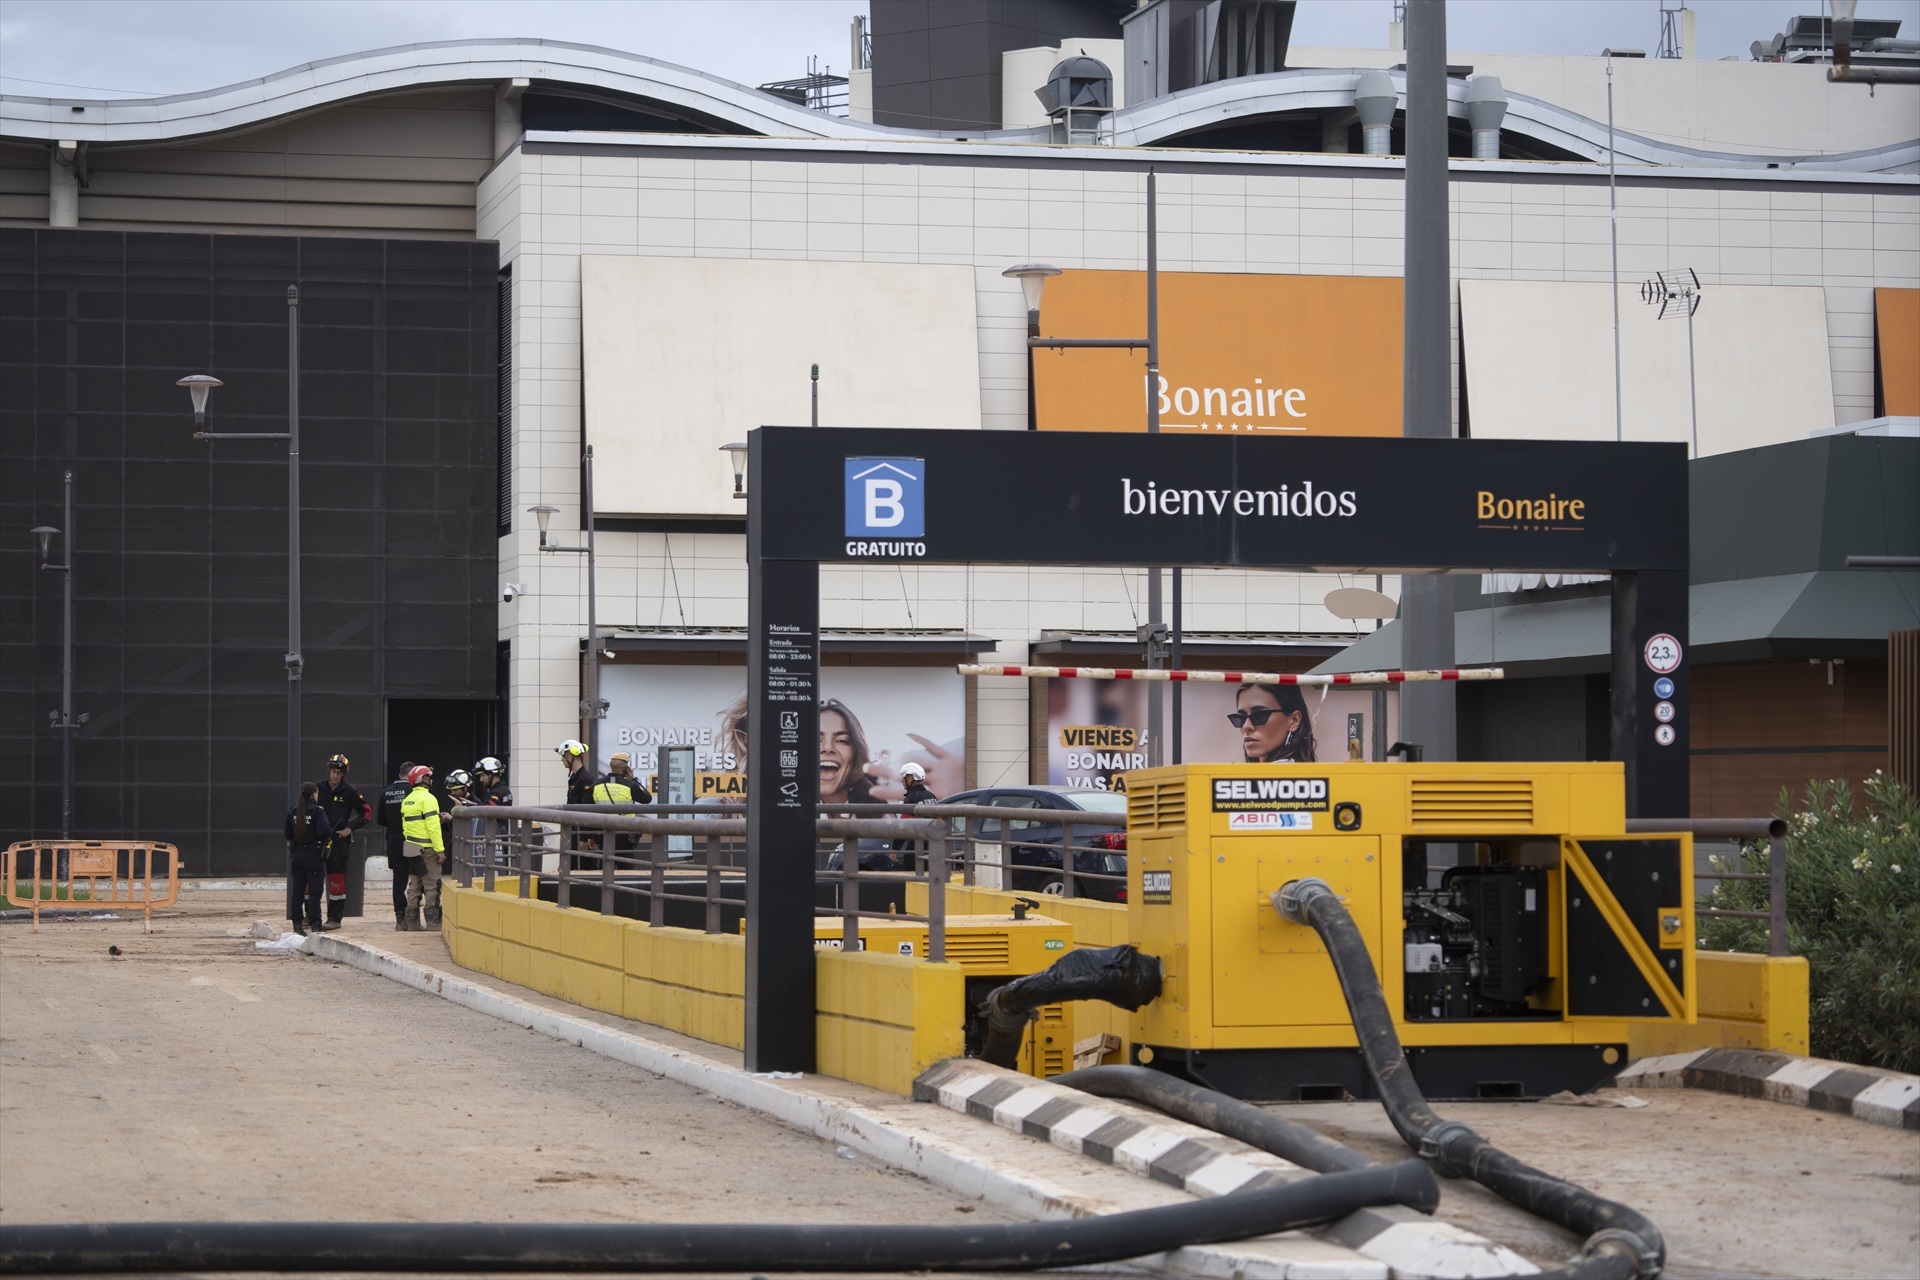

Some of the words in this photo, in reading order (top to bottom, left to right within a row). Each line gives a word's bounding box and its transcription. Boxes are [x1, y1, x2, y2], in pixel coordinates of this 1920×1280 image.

[1144, 374, 1307, 418] Bonaire
[864, 479, 905, 528] B
[1120, 478, 1358, 518] bienvenidos
[1477, 490, 1586, 521] Bonaire
[845, 541, 927, 557] GRATUITO
[769, 624, 800, 632] Horarios
[1660, 706, 1671, 714] 20
[618, 727, 712, 746] BONAIRE
[1063, 729, 1134, 747] VIENES
[711, 751, 737, 770] ES
[1067, 753, 1148, 770] BONAIR
[1215, 779, 1327, 800] SELWOOD
[1215, 800, 1327, 810] www.selwoodpumps.com
[1143, 872, 1171, 892] SELWOOD
